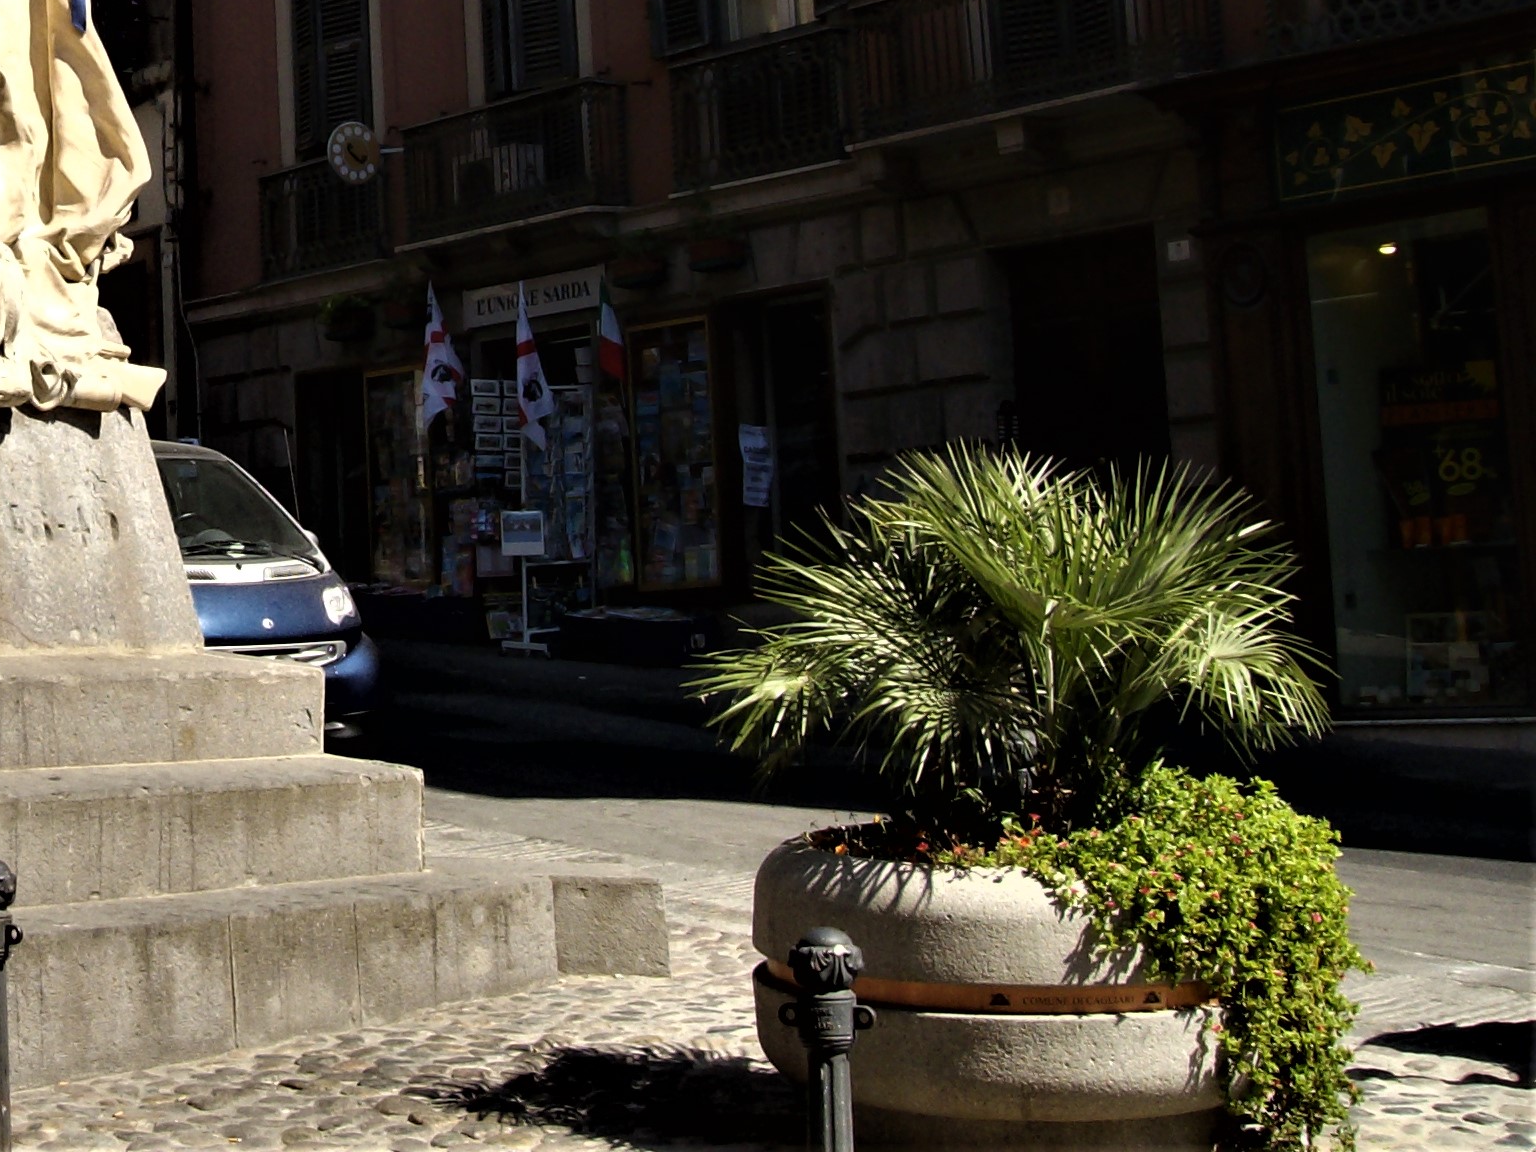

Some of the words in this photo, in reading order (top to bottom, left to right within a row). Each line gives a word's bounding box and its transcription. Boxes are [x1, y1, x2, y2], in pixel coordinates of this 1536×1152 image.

[543, 280, 591, 304] SARDA
[1022, 995, 1067, 1006] COMUNE
[1082, 994, 1135, 1006] CAGLIARI
